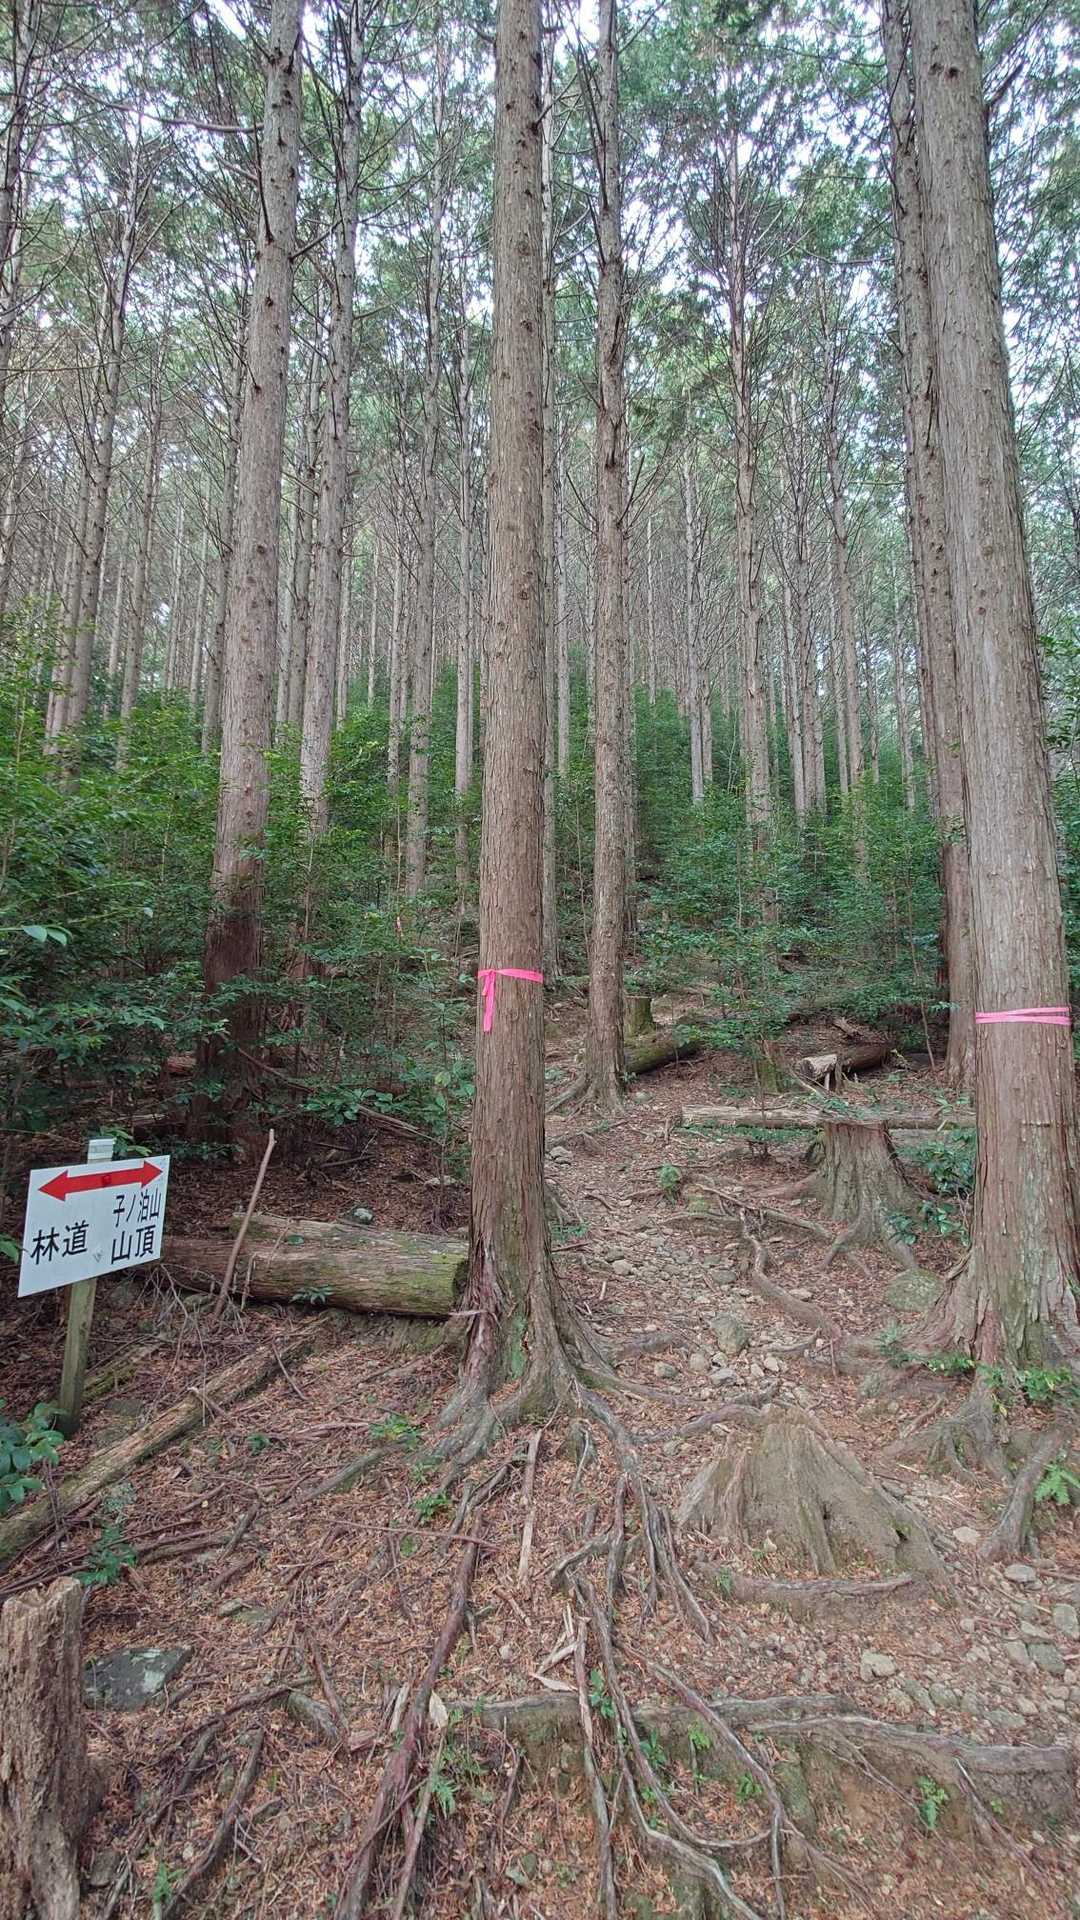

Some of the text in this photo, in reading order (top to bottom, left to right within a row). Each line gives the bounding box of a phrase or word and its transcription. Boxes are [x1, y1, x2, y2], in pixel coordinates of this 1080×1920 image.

[113, 1187, 162, 1228] 子ノ泊山
[30, 1220, 90, 1265] 林道
[111, 1224, 156, 1264] 山頂
